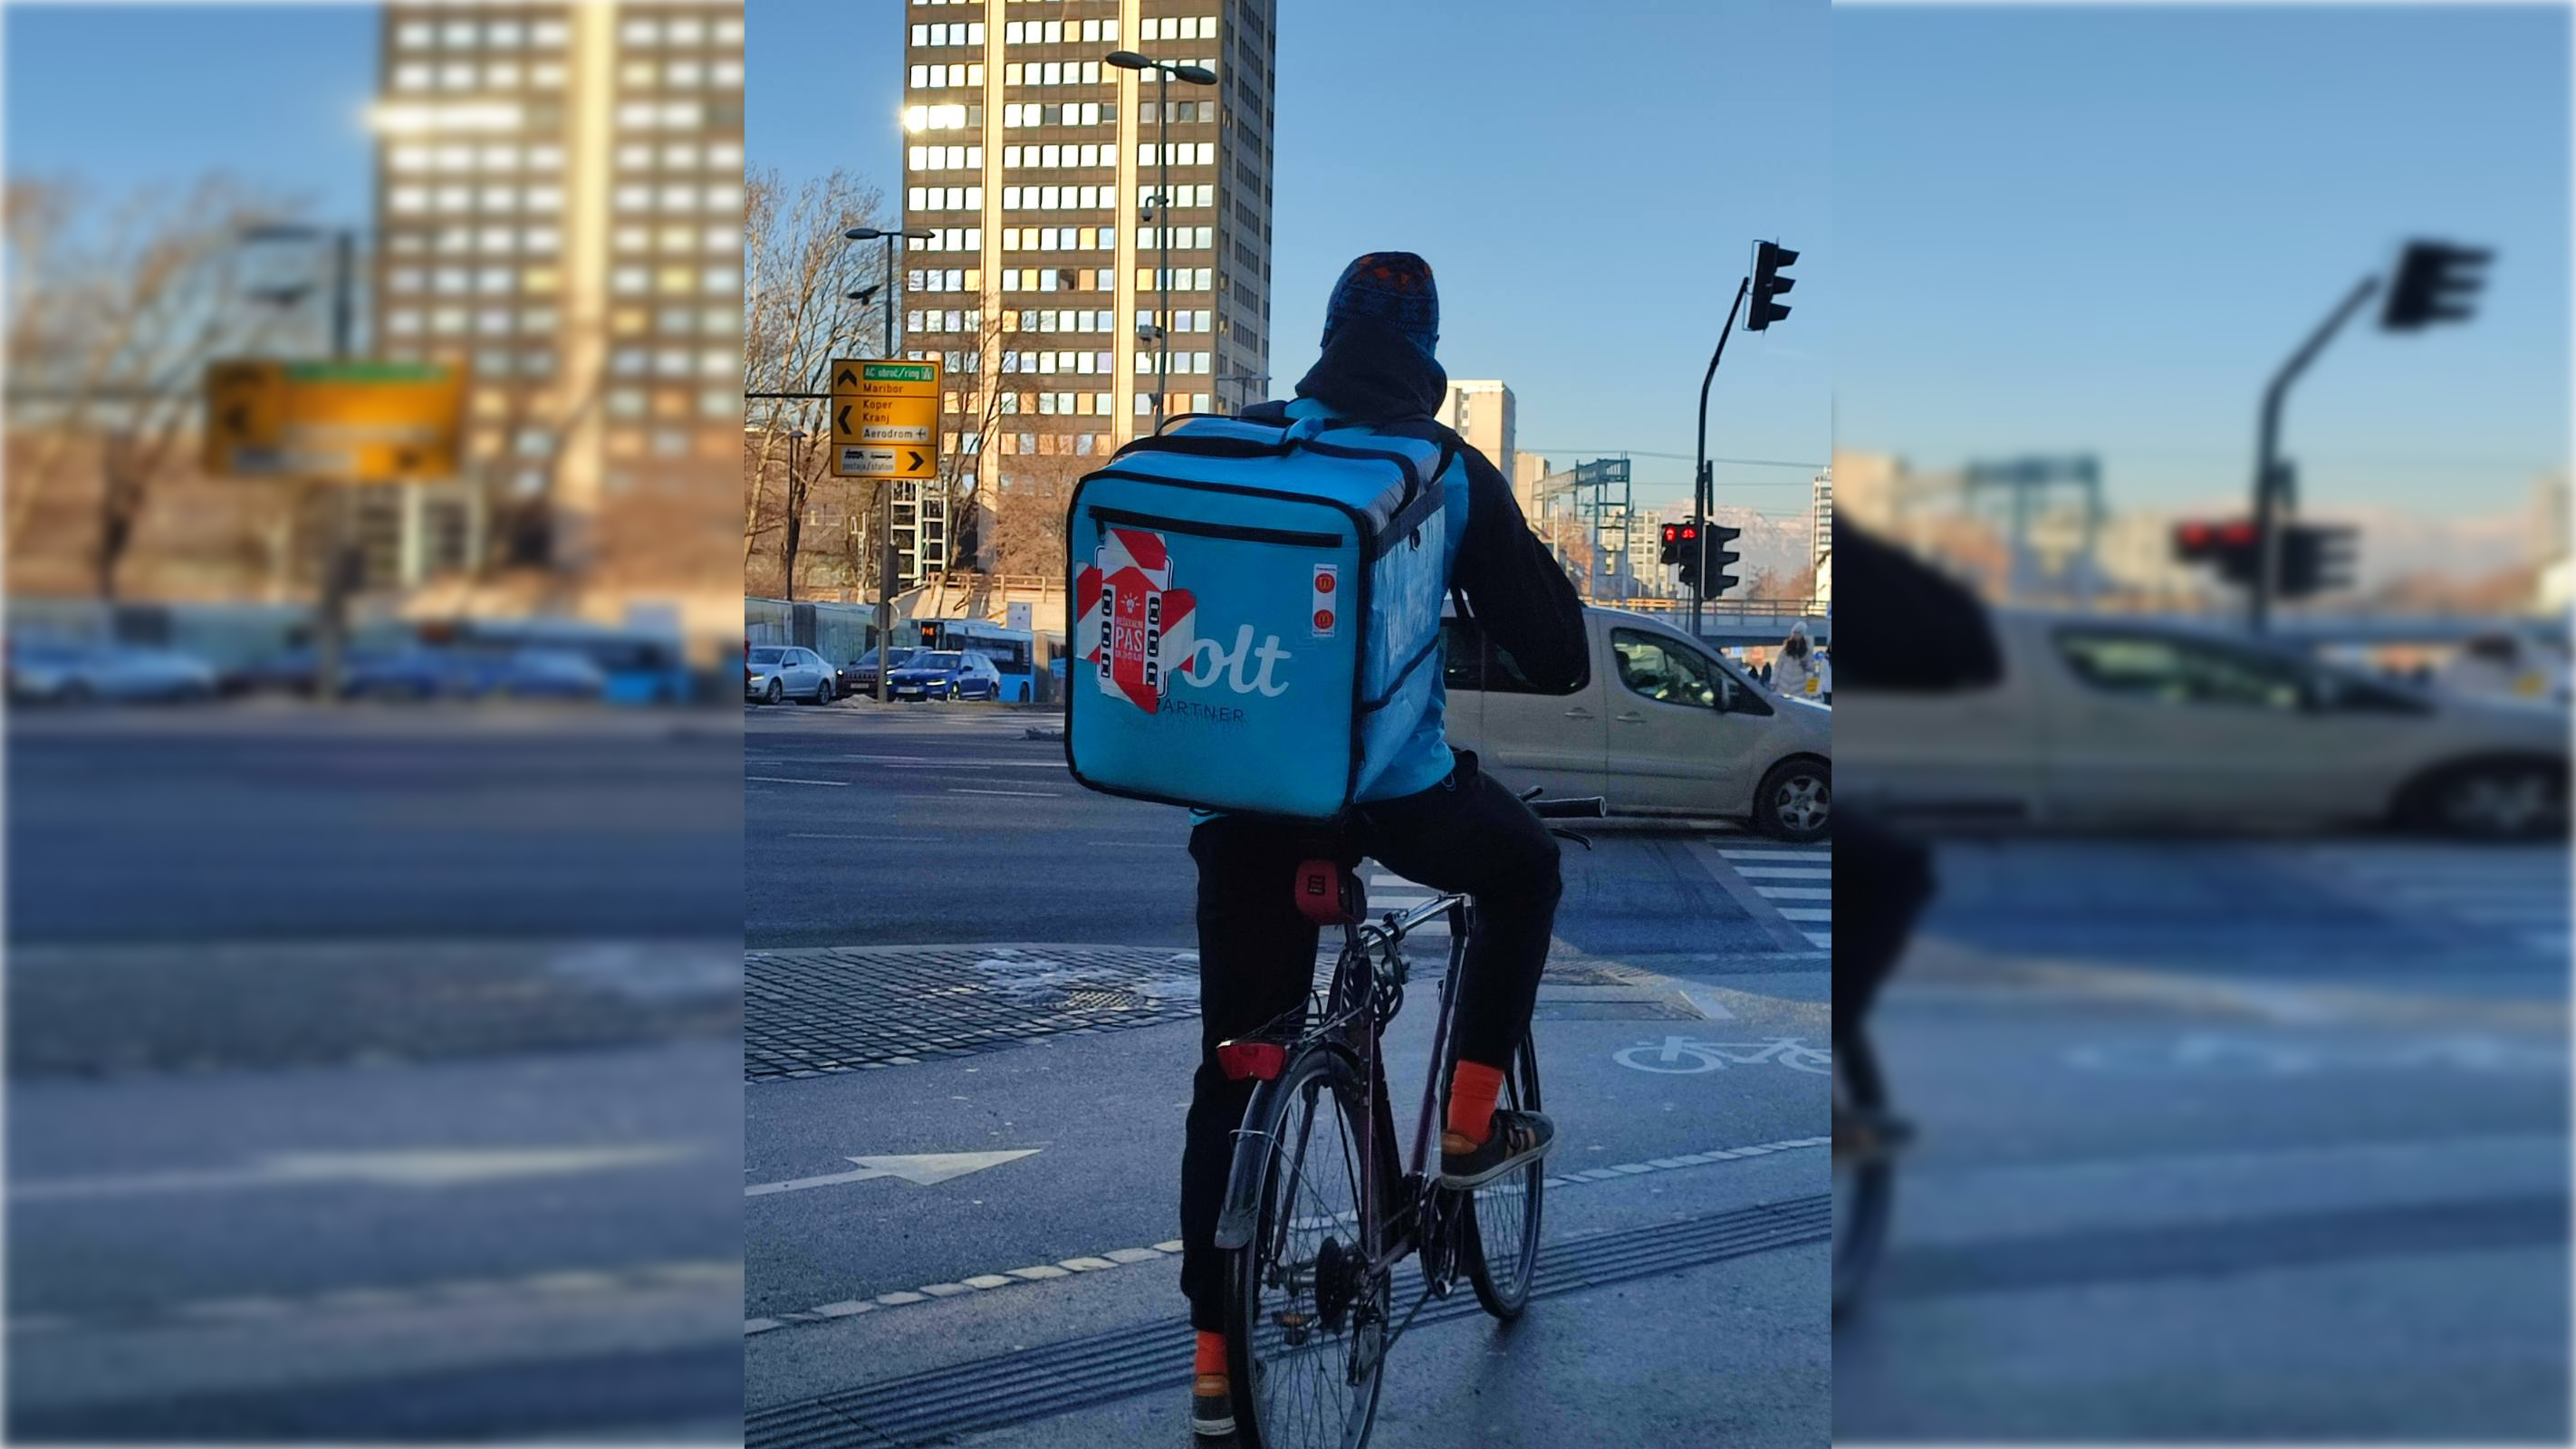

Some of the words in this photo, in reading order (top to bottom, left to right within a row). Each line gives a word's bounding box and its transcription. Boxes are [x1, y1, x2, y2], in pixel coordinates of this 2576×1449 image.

[865, 368, 876, 377] AC
[863, 384, 904, 394] Maribor
[863, 399, 893, 410] Koper
[863, 414, 890, 425] Kranj
[863, 428, 913, 438] Aerodrom
[1115, 626, 1143, 653] PAS
[1181, 623, 1293, 697] olt
[1157, 698, 1245, 723] ARTNER
